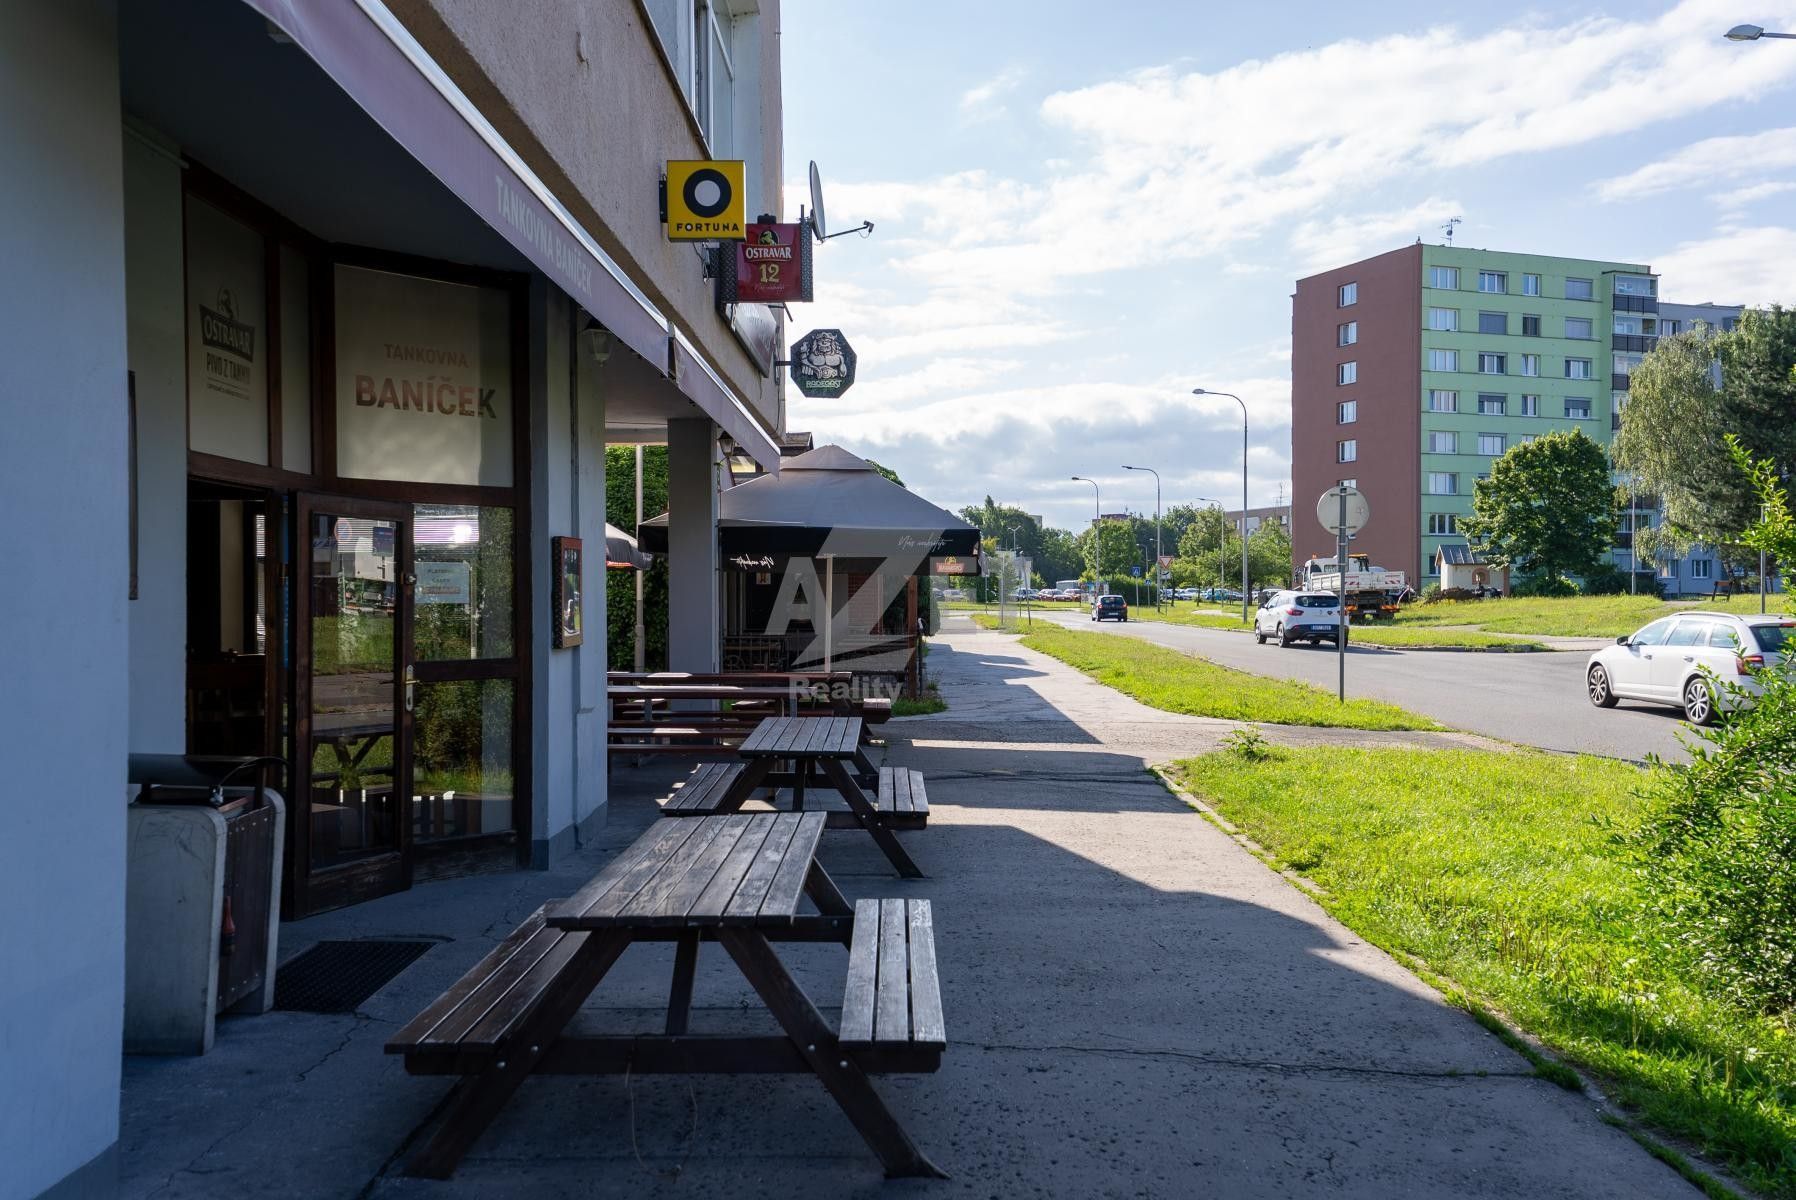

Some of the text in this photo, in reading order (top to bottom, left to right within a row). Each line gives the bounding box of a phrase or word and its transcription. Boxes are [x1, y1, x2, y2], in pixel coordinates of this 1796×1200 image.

[496, 175, 554, 262] TANKOVNA
[676, 223, 739, 231] FORTUNA
[745, 247, 792, 259] OSTRAVAR
[760, 263, 779, 283] 12
[204, 315, 251, 355] OSTRAVAR
[384, 344, 469, 368] TANKOVNA
[355, 374, 496, 419] BANÍČEK
